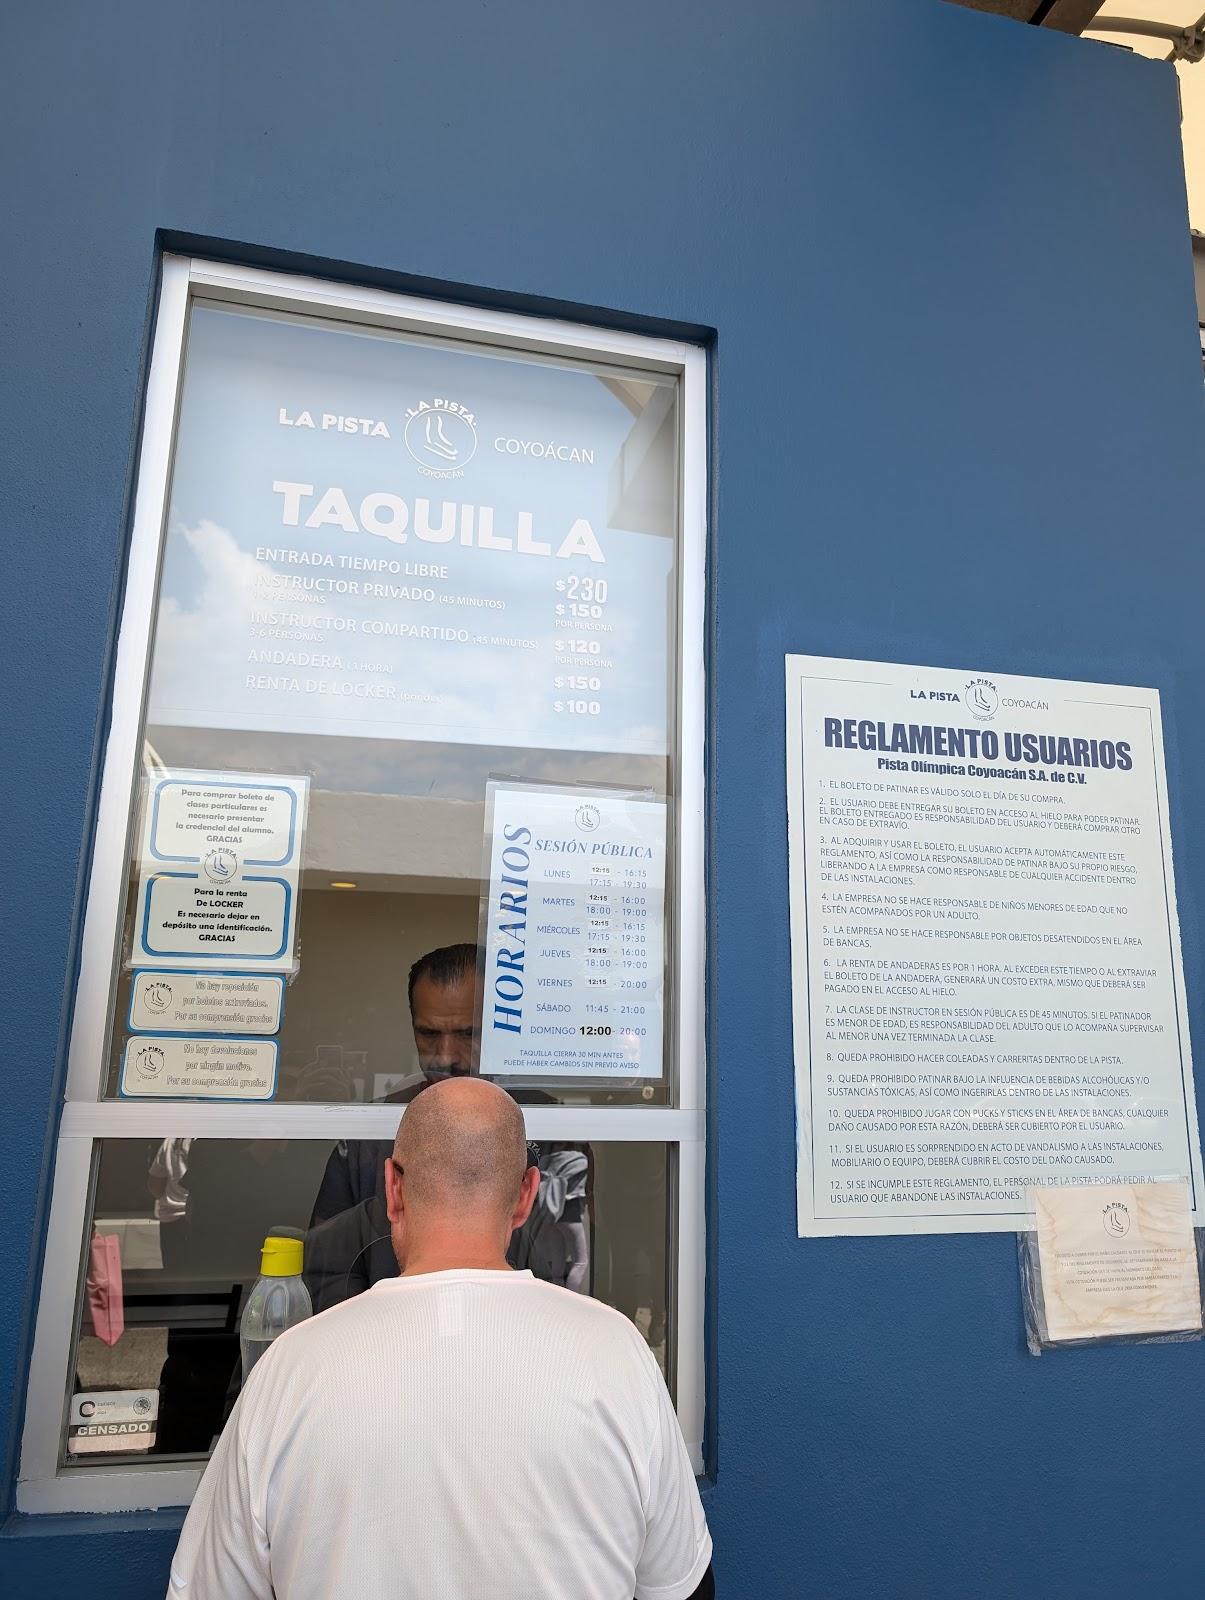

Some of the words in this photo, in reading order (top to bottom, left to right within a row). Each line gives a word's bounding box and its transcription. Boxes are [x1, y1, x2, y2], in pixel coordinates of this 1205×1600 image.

[407, 401, 430, 416] LA
[434, 399, 475, 425] PISTA
[279, 408, 315, 428] LA
[322, 414, 390, 438] PISTA
[273, 481, 605, 563] TAQUILLA
[256, 547, 334, 567] ENTRADA
[338, 555, 400, 573] TIEMPO
[405, 562, 448, 578] LIBRE
[256, 574, 359, 594] INSTRUCTOR
[364, 583, 435, 601] PRIVADO
[439, 595, 455, 606] (45
[457, 596, 506, 610] MINUTOS)
[251, 608, 356, 631] INSTRUCTOR
[361, 620, 469, 642] COMPARTIDO
[248, 647, 345, 672] ANDADERA
[245, 675, 303, 694] RENTA
[305, 679, 332, 695] DE
[332, 681, 396, 699] LOCKER
[977, 679, 997, 692] PISTA
[910, 690, 927, 699] LA
[929, 691, 960, 702] PISTA
[825, 718, 998, 760] REGLAMENTO
[1004, 732, 1132, 771] USUARIOS
[877, 757, 909, 772] Pista
[911, 760, 966, 776] Olímpica
[967, 764, 1027, 780] Coyoacán
[1028, 769, 1049, 782] S.A.
[1050, 771, 1065, 783] de
[1067, 772, 1087, 784] C.V.
[181, 789, 201, 797] Para
[202, 792, 237, 800] comprar
[238, 792, 263, 801] boleto
[264, 794, 274, 802] de
[819, 780, 826, 788] 1.
[830, 780, 839, 789] EL
[841, 781, 872, 791] BOLETO
[873, 783, 884, 792] DE
[886, 784, 919, 794] PATINAR
[920, 786, 929, 795] ES
[930, 786, 959, 797] VÁLIDO
[960, 789, 981, 798] SOLO
[983, 791, 992, 799] EL
[993, 791, 1007, 800] DÍA
[1008, 792, 1018, 801] DE
[1020, 794, 1030, 802] SU
[1031, 794, 1065, 804] COMPRA.
[186, 800, 209, 808] clases
[210, 803, 258, 811] particulares
[188, 813, 225, 821] necesario
[226, 815, 265, 823] presentar
[175, 822, 183, 830] la
[185, 823, 226, 831] credencial
[227, 825, 240, 833] del
[241, 826, 274, 834] alumno.
[206, 835, 242, 843] GRACIAS
[535, 839, 588, 853] SESIÓN
[591, 842, 652, 858] PÚBLICA
[544, 869, 571, 879] LUNES
[625, 869, 647, 878] 16:15
[820, 860, 867, 871] LIBERANDO
[869, 863, 875, 871] A
[876, 863, 887, 871] LA
[889, 864, 925, 874] EMPRESA
[926, 866, 952, 876] COMO
[953, 867, 1007, 878] RESPONSABLE
[1009, 870, 1020, 879] DE
[1021, 871, 1063, 881] CUALQUIER
[1065, 874, 1105, 883] ACCIDENTE
[1106, 875, 1136, 885] DENTRO
[590, 878, 611, 888] 17:15
[623, 881, 647, 890] 19:30
[194, 888, 214, 896] Para
[216, 889, 224, 897] la
[226, 890, 248, 898] renta
[589, 894, 607, 902] 12:15
[210, 900, 244, 908] LOCKER
[543, 897, 575, 906] MARTES
[621, 896, 646, 905] 16:00
[177, 910, 186, 918] Es
[188, 912, 225, 920] necesario
[227, 912, 248, 921] dejar
[586, 906, 611, 915] 18:00
[622, 908, 647, 917] 19:00
[162, 921, 197, 930] depósito
[217, 923, 273, 932] identificación.
[494, 824, 532, 1034] HORARIOS
[537, 924, 580, 935] MIÉRCOLES
[623, 922, 645, 931] 16:15
[198, 934, 235, 942] GRACIAS
[588, 932, 610, 941] 17:15
[622, 934, 646, 943] 19:30
[540, 949, 571, 958] JUEVES
[621, 948, 646, 957] 16:00
[585, 959, 611, 968] 18:00
[622, 960, 647, 969] 19:00
[537, 978, 572, 987] VIERNES
[620, 980, 647, 989] 20:00
[536, 1002, 571, 1013] SÁBADO
[586, 1004, 609, 1013] 11:45
[620, 1006, 645, 1015] 21:00
[530, 1026, 576, 1035] DOMINGO
[579, 1026, 611, 1035] 12:00
[620, 1027, 646, 1036] 20:00
[520, 1049, 552, 1057] TAQUILLA
[553, 1050, 577, 1058] CIERRA
[578, 1051, 586, 1059] 30
[588, 1051, 601, 1059] MIN
[603, 1052, 624, 1060] ANTES
[826, 1053, 834, 1061] 8.
[837, 1052, 868, 1062] QUEDA
[870, 1053, 916, 1062] PROHIBIDO
[917, 1054, 945, 1063] HACER
[946, 1054, 989, 1063] COLEADAS
[989, 1055, 995, 1063] Y
[996, 1055, 1043, 1064] CARRERITAS
[1044, 1055, 1076, 1064] DENTRO
[1077, 1056, 1088, 1064] DE
[1090, 1056, 1100, 1064] LA
[1101, 1056, 1124, 1065] PISTA.
[504, 1059, 525, 1067] PUEDE
[526, 1060, 549, 1068] HABER
[549, 1060, 581, 1068] CAMBIOS
[582, 1061, 594, 1069] SIN
[595, 1061, 618, 1069] PREVIO
[619, 1062, 640, 1070] AVISO
[77, 1423, 149, 1435] CENSADO
